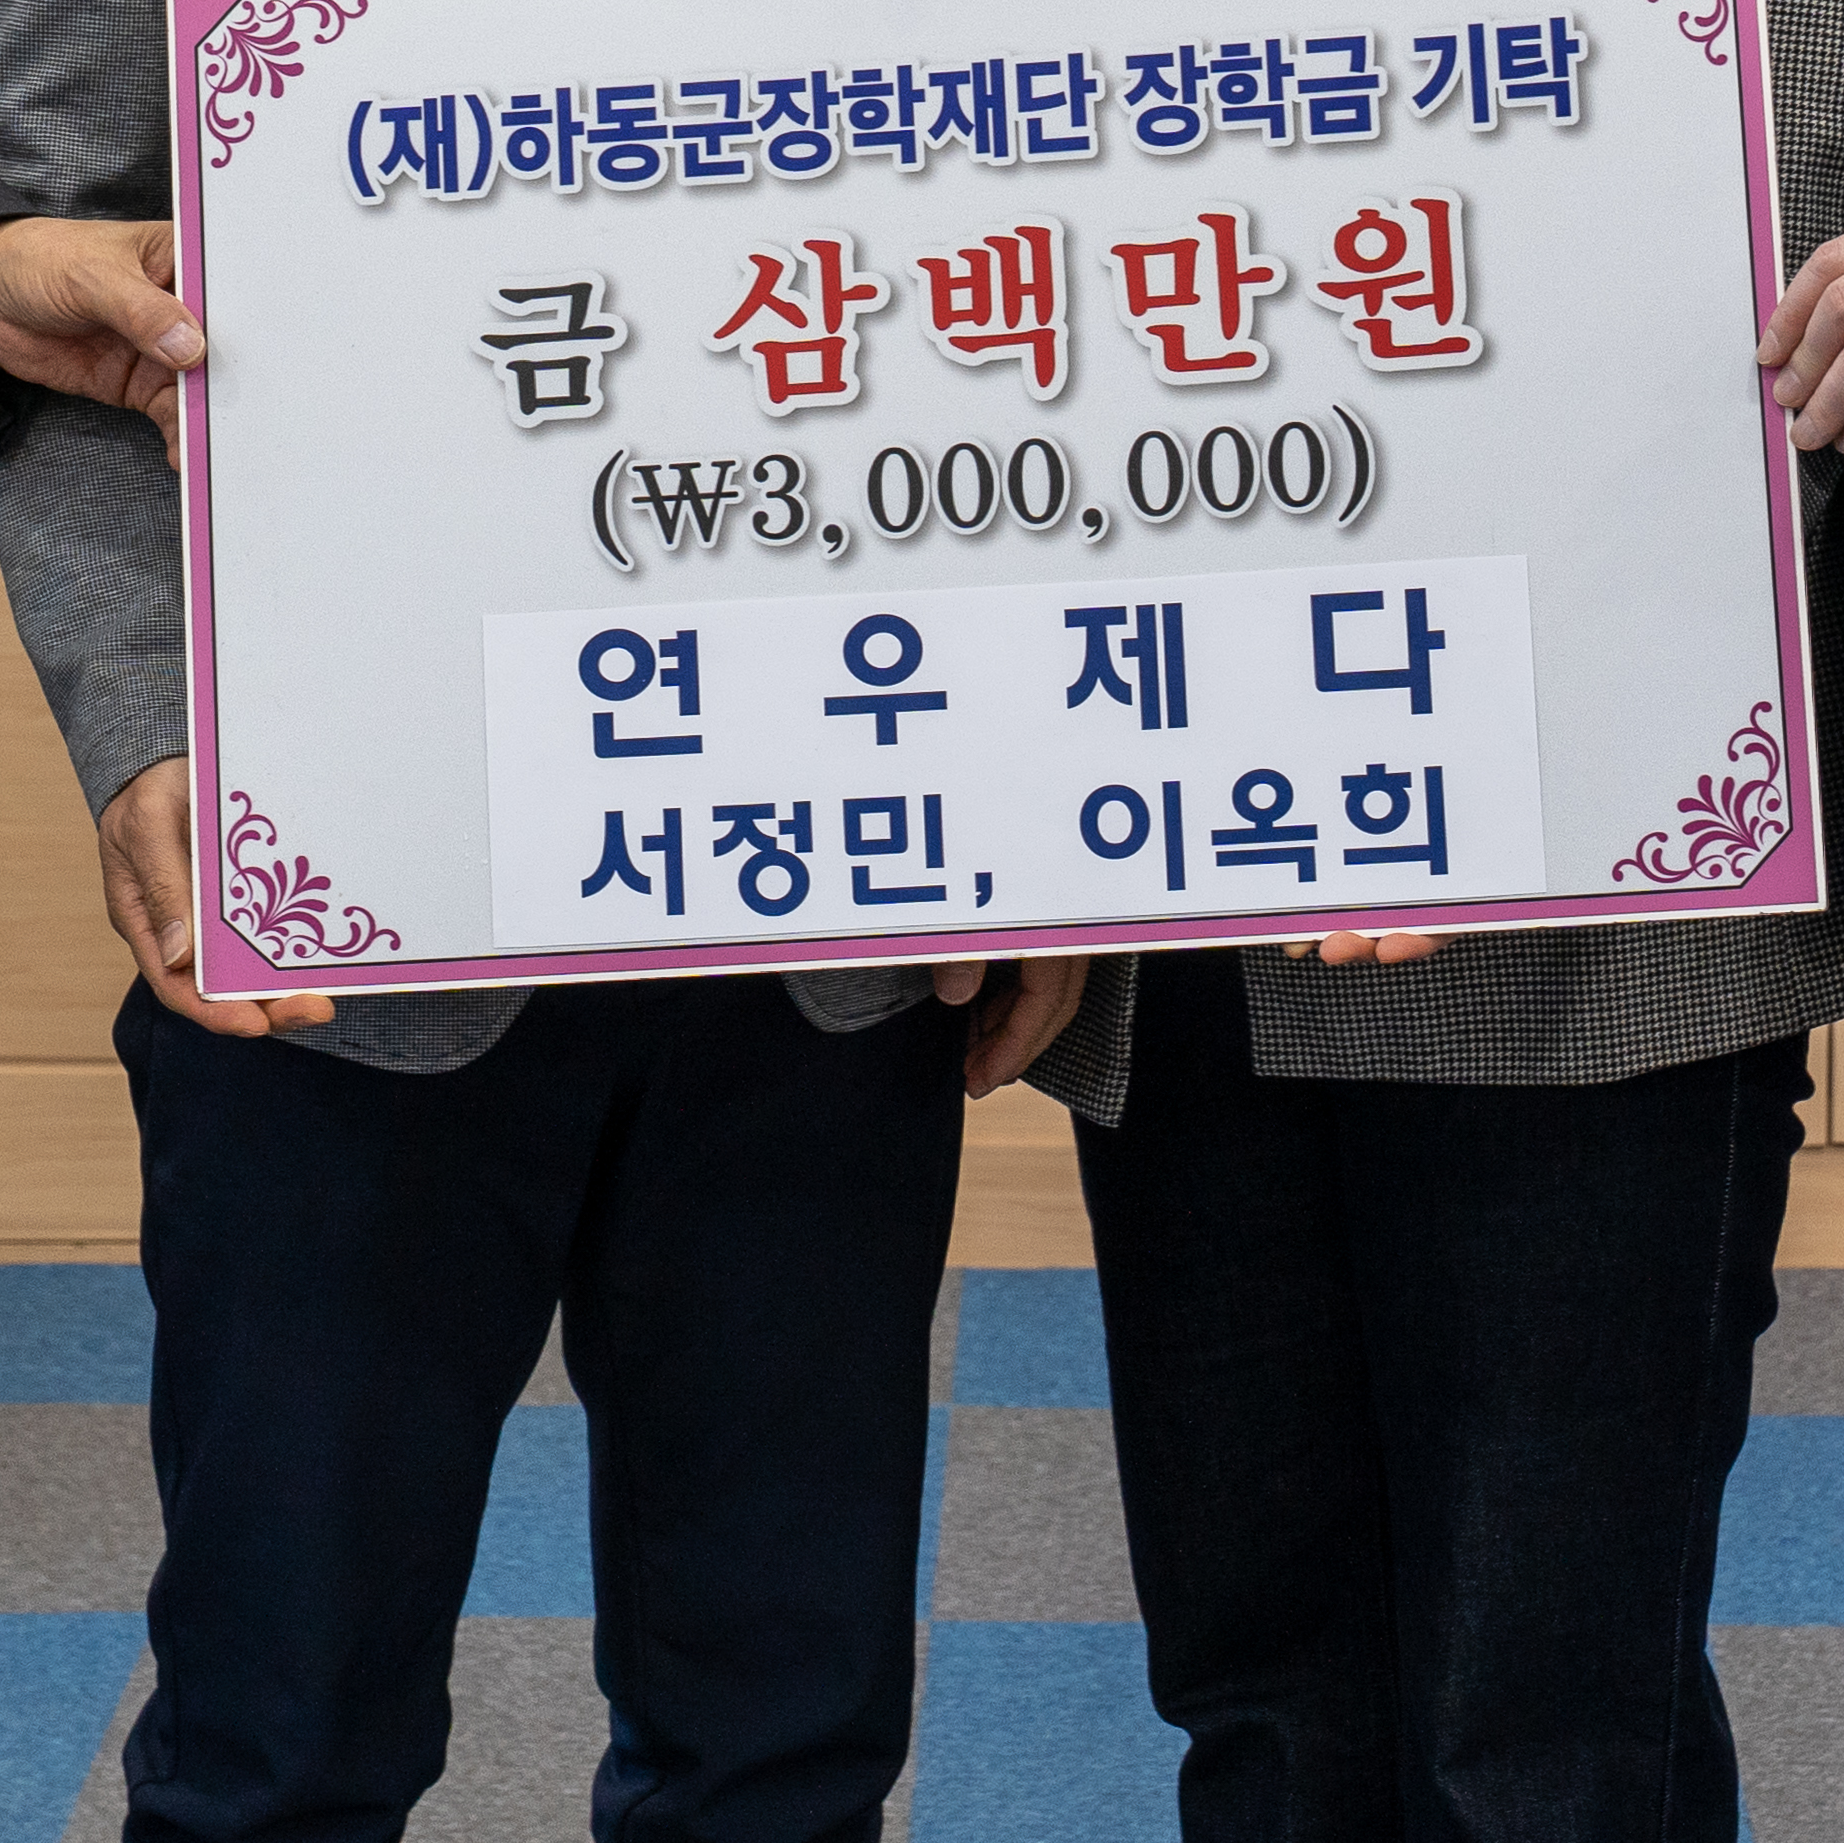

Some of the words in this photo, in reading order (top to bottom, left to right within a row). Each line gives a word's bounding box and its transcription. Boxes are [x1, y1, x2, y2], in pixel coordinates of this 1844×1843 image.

[347, 53, 1098, 199] (재)하동군장학재단
[1125, 36, 1380, 148] 장학금
[1413, 18, 1581, 124] 기탁
[480, 281, 615, 414] 금
[593, 404, 1371, 566] (₩3,000,000)
[581, 794, 993, 917] 서정민,
[1080, 764, 1449, 891] 이옥희
